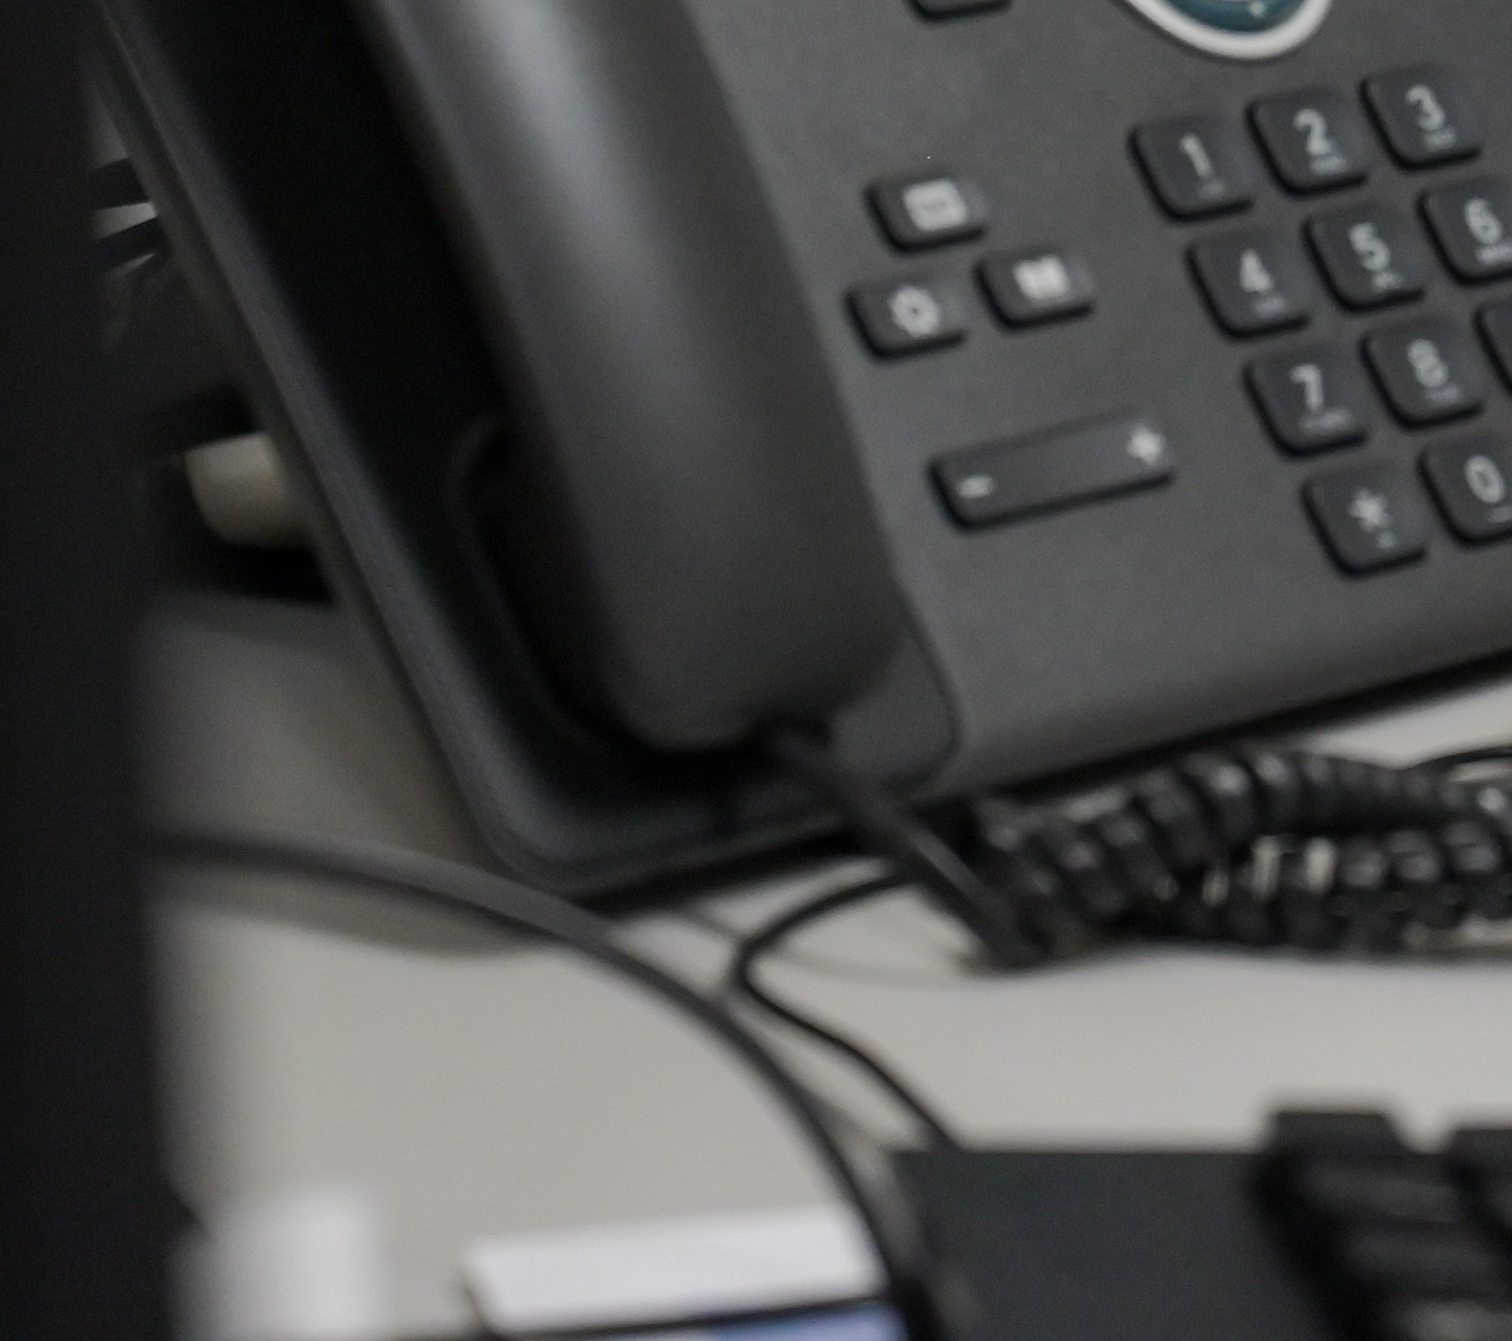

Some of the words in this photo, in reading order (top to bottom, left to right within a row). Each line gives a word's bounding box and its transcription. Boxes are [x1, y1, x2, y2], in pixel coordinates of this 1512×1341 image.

[1179, 132, 1212, 178] 1
[1293, 108, 1334, 156] 2
[1404, 84, 1446, 132] 3
[1239, 248, 1274, 294] 4
[1348, 221, 1391, 273] 5
[1464, 198, 1503, 244] 6
[1288, 362, 1325, 412] 7
[1406, 338, 1449, 389] 8
[1463, 454, 1506, 505] 0
